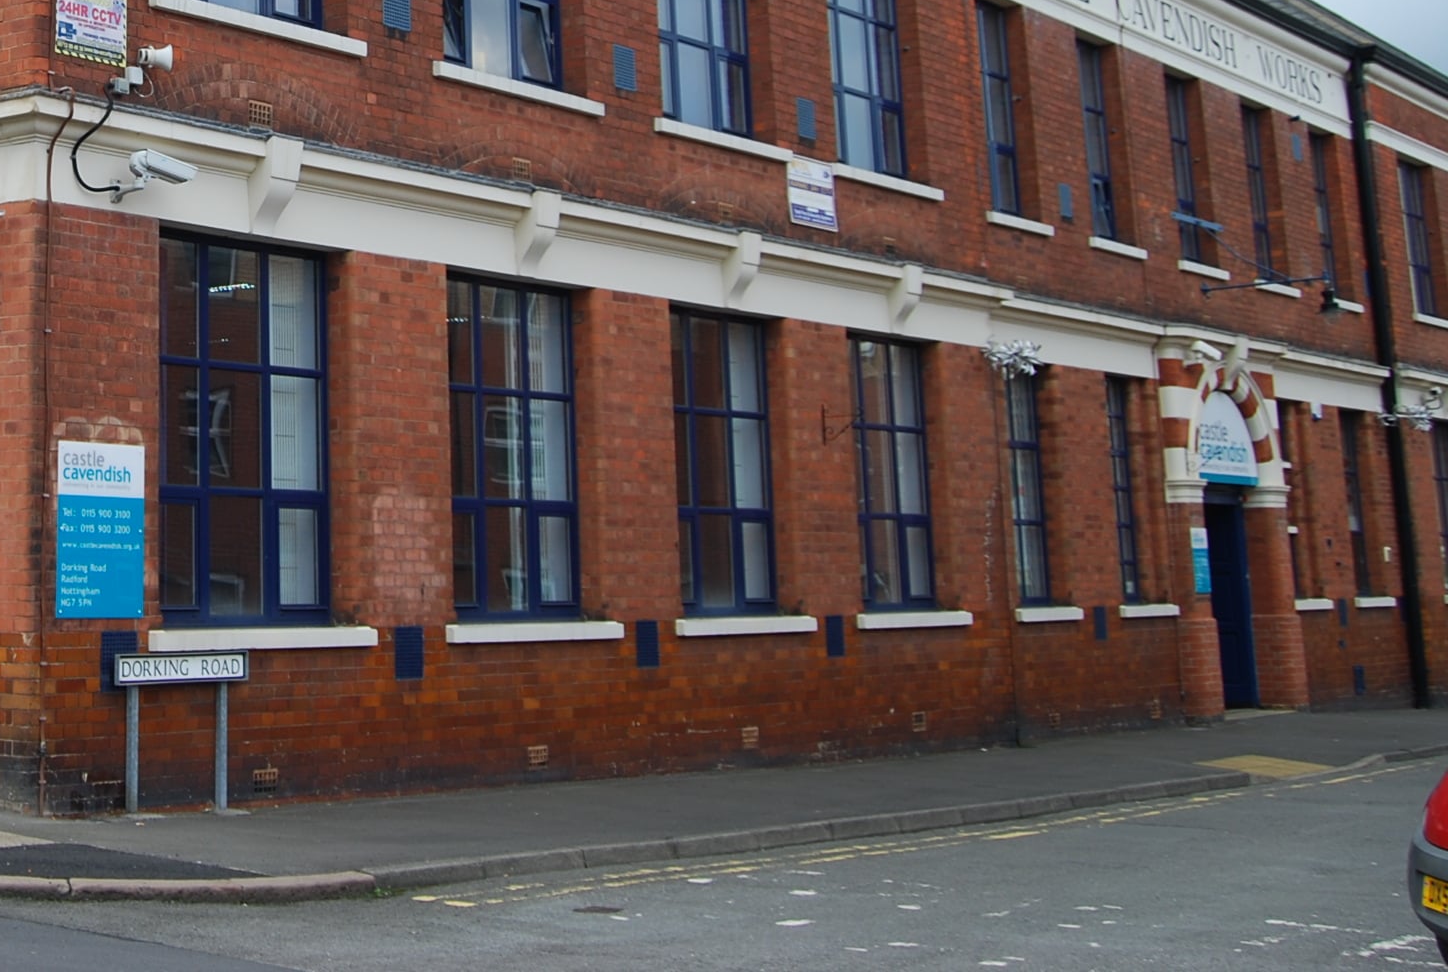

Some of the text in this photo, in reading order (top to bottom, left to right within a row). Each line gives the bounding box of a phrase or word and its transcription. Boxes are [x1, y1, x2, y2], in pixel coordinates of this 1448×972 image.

[59, 0, 121, 25] 24HR CCTV
[1256, 44, 1324, 105] WORKS
[1199, 420, 1228, 442] castle
[63, 450, 105, 467] castle
[1199, 441, 1249, 463] cavendish
[63, 466, 132, 483] cavendish
[62, 508, 131, 519] Tel: 0115 900 3100
[80, 524, 95, 533] 0115
[98, 524, 112, 533] 900
[114, 525, 131, 534] 3200
[61, 563, 107, 573] Dorking Road
[61, 574, 88, 583] Radford
[61, 587, 101, 597] Nottingham
[60, 598, 76, 607] NG7
[120, 658, 241, 678] DORKING ROAD
